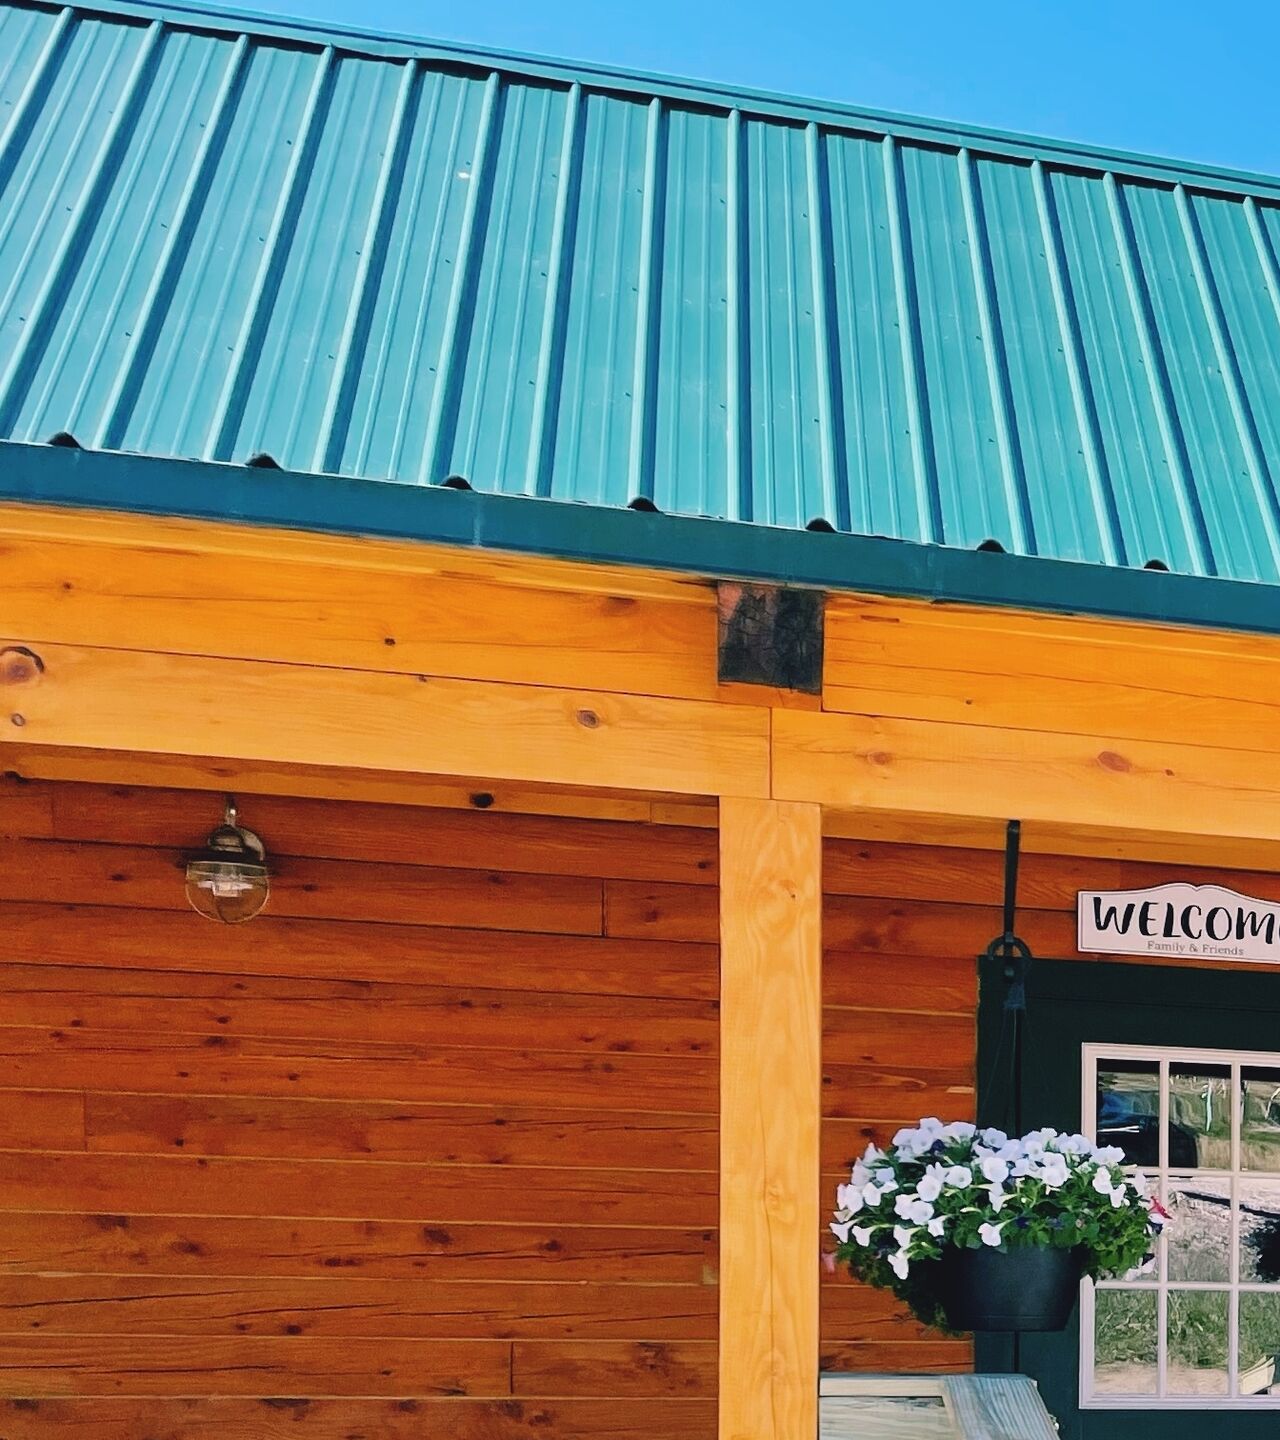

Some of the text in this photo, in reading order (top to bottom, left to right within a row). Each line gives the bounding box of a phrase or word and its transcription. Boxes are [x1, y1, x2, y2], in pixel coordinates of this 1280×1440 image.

[1147, 940, 1245, 956] Family & Friends
